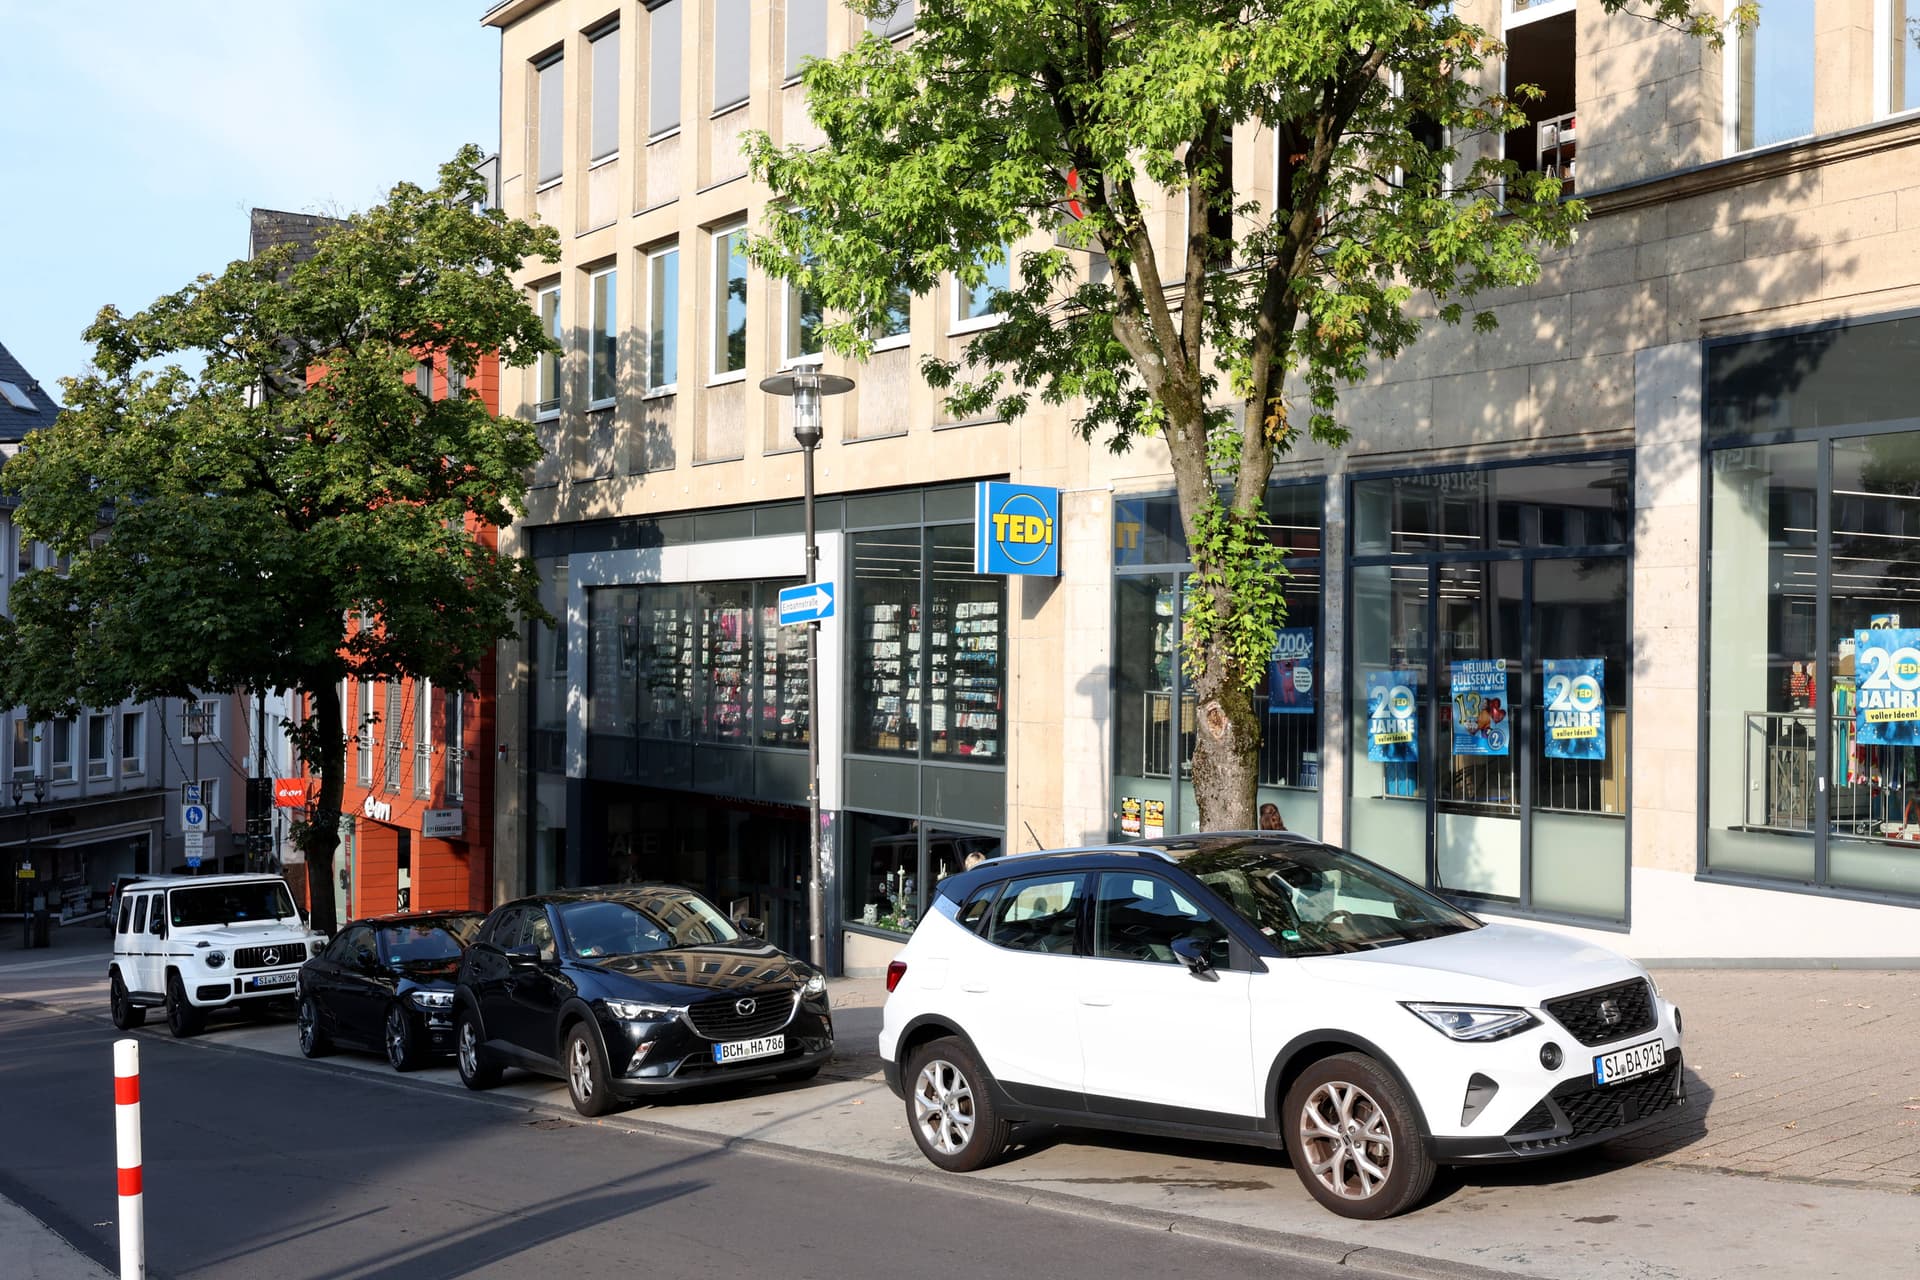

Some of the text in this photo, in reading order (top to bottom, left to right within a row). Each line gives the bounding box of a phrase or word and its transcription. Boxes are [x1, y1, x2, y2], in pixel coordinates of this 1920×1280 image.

[992, 513, 1053, 545] TEDi
[782, 598, 818, 611] Einbahnstraße
[1453, 672, 1505, 685] FÜLLSERVICE
[1860, 647, 1920, 690] 20
[1370, 685, 1415, 719] 20
[1547, 674, 1600, 712] 20
[1547, 711, 1600, 728] JAHRE
[1871, 710, 1918, 720] voller Ideen!
[1370, 719, 1415, 734] JAHRE
[722, 1037, 783, 1058] BCH HA 786
[1605, 1055, 1621, 1079] SI
[1625, 1050, 1642, 1073] BA
[1643, 1044, 1662, 1068] 913
